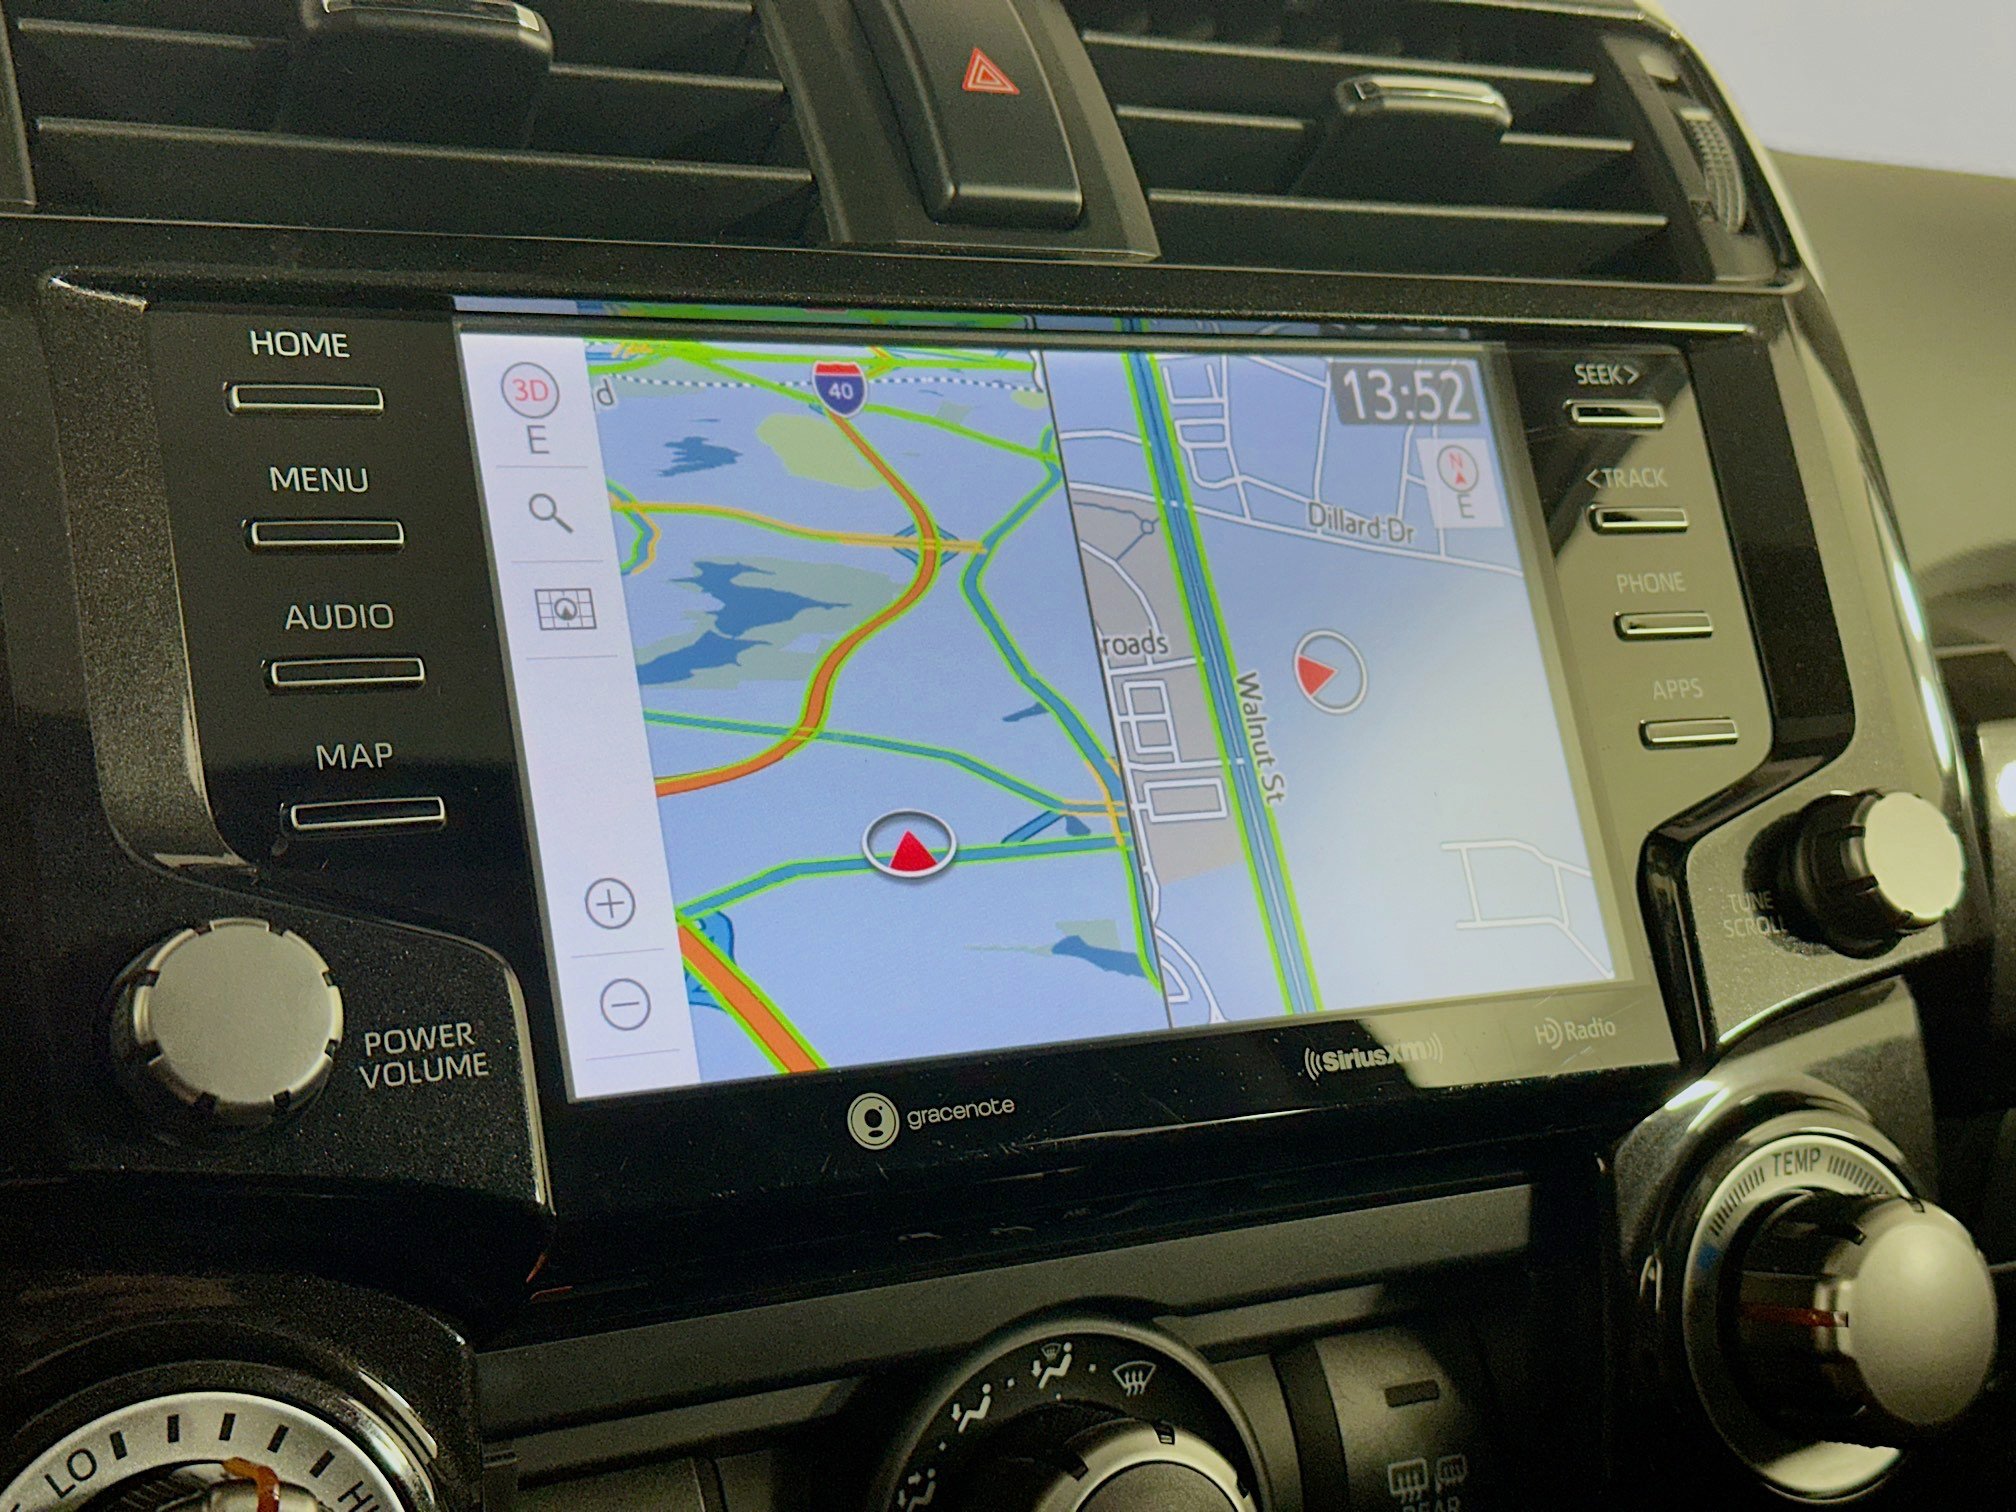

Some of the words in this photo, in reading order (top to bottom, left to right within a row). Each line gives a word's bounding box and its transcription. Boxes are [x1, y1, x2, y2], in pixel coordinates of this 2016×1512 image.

[250, 329, 350, 358] HOME
[512, 378, 549, 402] 3D
[828, 382, 854, 400] 40
[1343, 368, 1473, 421] 13:52
[527, 424, 550, 454] E
[1449, 451, 1464, 469] N
[269, 466, 369, 493] MENU
[1456, 493, 1476, 520] E
[1308, 501, 1381, 540] Dillard
[1387, 516, 1415, 544] Dr
[1616, 571, 1686, 594] PHONE
[285, 603, 394, 631] AUDIO
[1102, 628, 1169, 656] roads
[1652, 677, 1703, 701] APPS
[1235, 671, 1276, 768] Walnut
[1260, 773, 1285, 805] St
[315, 742, 393, 771] MAP
[1727, 890, 1775, 913] TUNE
[1723, 914, 1790, 938] SCROLL
[364, 1022, 476, 1057] POWER
[1564, 1016, 1616, 1042] Radio
[358, 1051, 490, 1090] VOLUME
[906, 1097, 1016, 1131] gracenote
[1771, 1146, 1822, 1177] TEMP
[44, 1447, 98, 1498] LO
